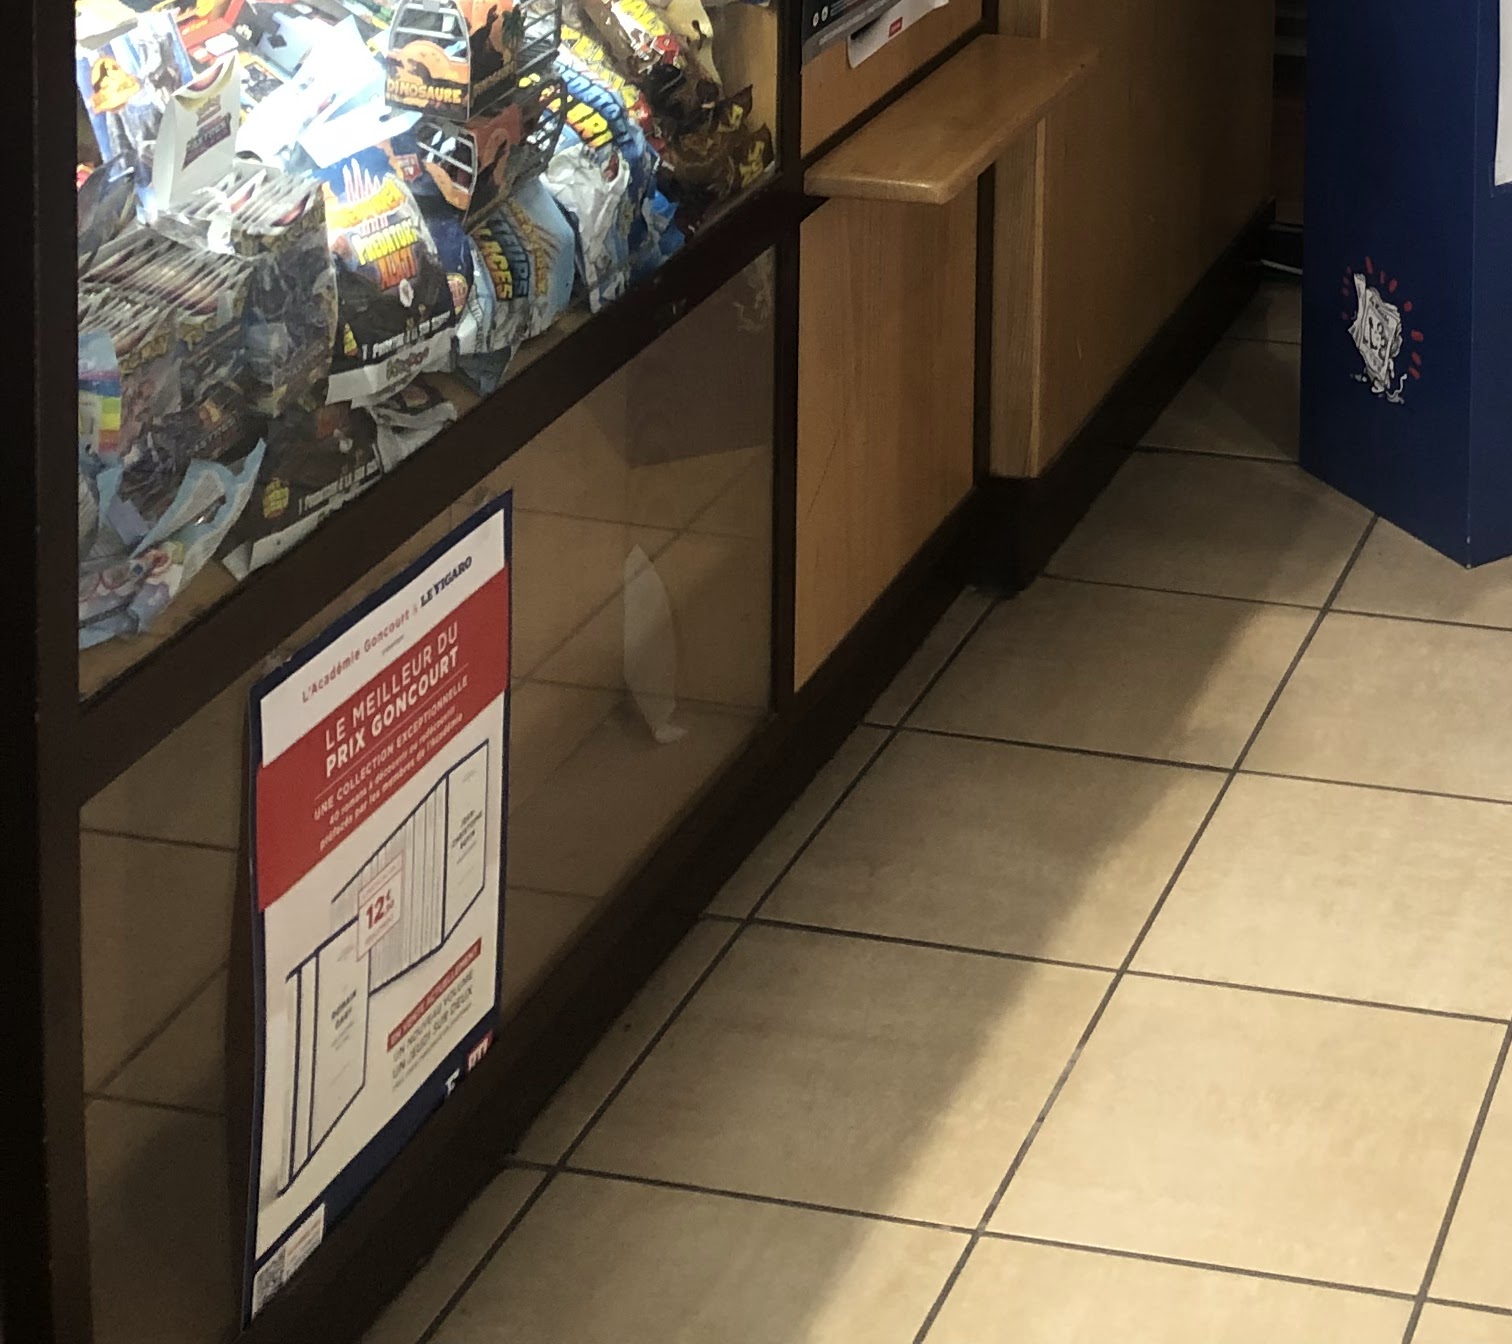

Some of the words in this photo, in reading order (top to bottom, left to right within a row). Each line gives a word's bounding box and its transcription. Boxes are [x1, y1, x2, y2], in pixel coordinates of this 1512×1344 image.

[387, 80, 462, 103] DINOSAURE
[302, 650, 360, 703] L'Académie
[364, 609, 410, 653] Goncourt
[433, 556, 472, 596] FIGARO
[325, 722, 345, 751] LE
[352, 645, 432, 730] MEILLEUR
[437, 622, 458, 654] DU
[314, 798, 334, 821] UNE
[336, 744, 394, 803] COLLECTION
[396, 675, 468, 749] EXCEPTIONNELLE
[326, 727, 365, 778] PRIX
[371, 646, 459, 739] GONCOURT
